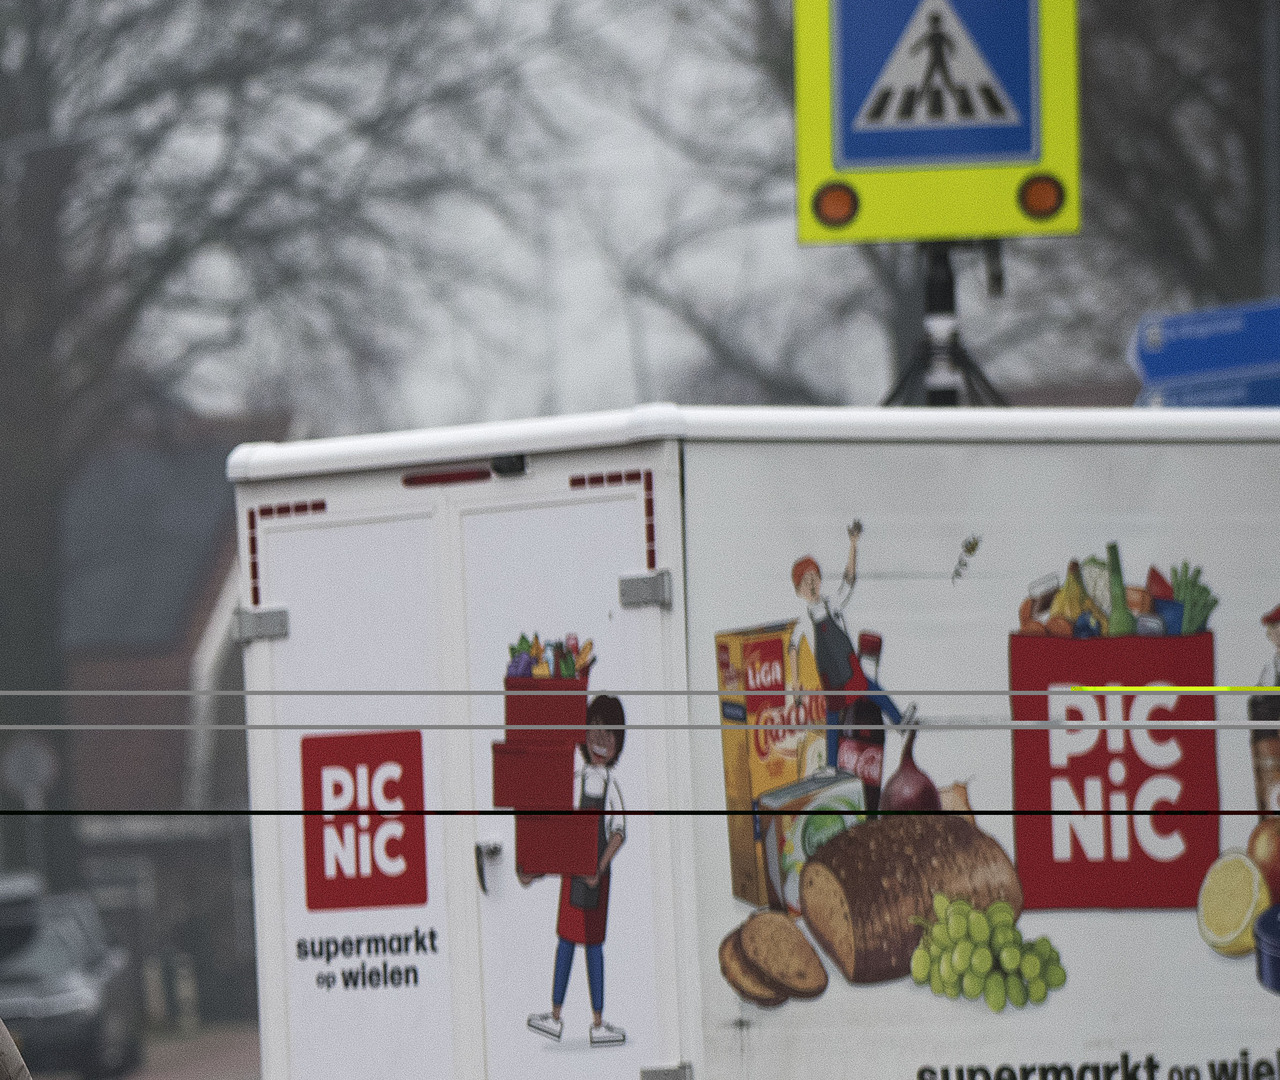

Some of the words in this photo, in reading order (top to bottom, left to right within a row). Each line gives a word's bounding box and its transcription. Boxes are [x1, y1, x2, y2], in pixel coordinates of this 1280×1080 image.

[1048, 681, 1183, 769] PIC
[321, 761, 405, 822] PIC
[296, 926, 438, 964] supermarkt
[316, 971, 336, 991] op
[341, 961, 420, 990] wielen
